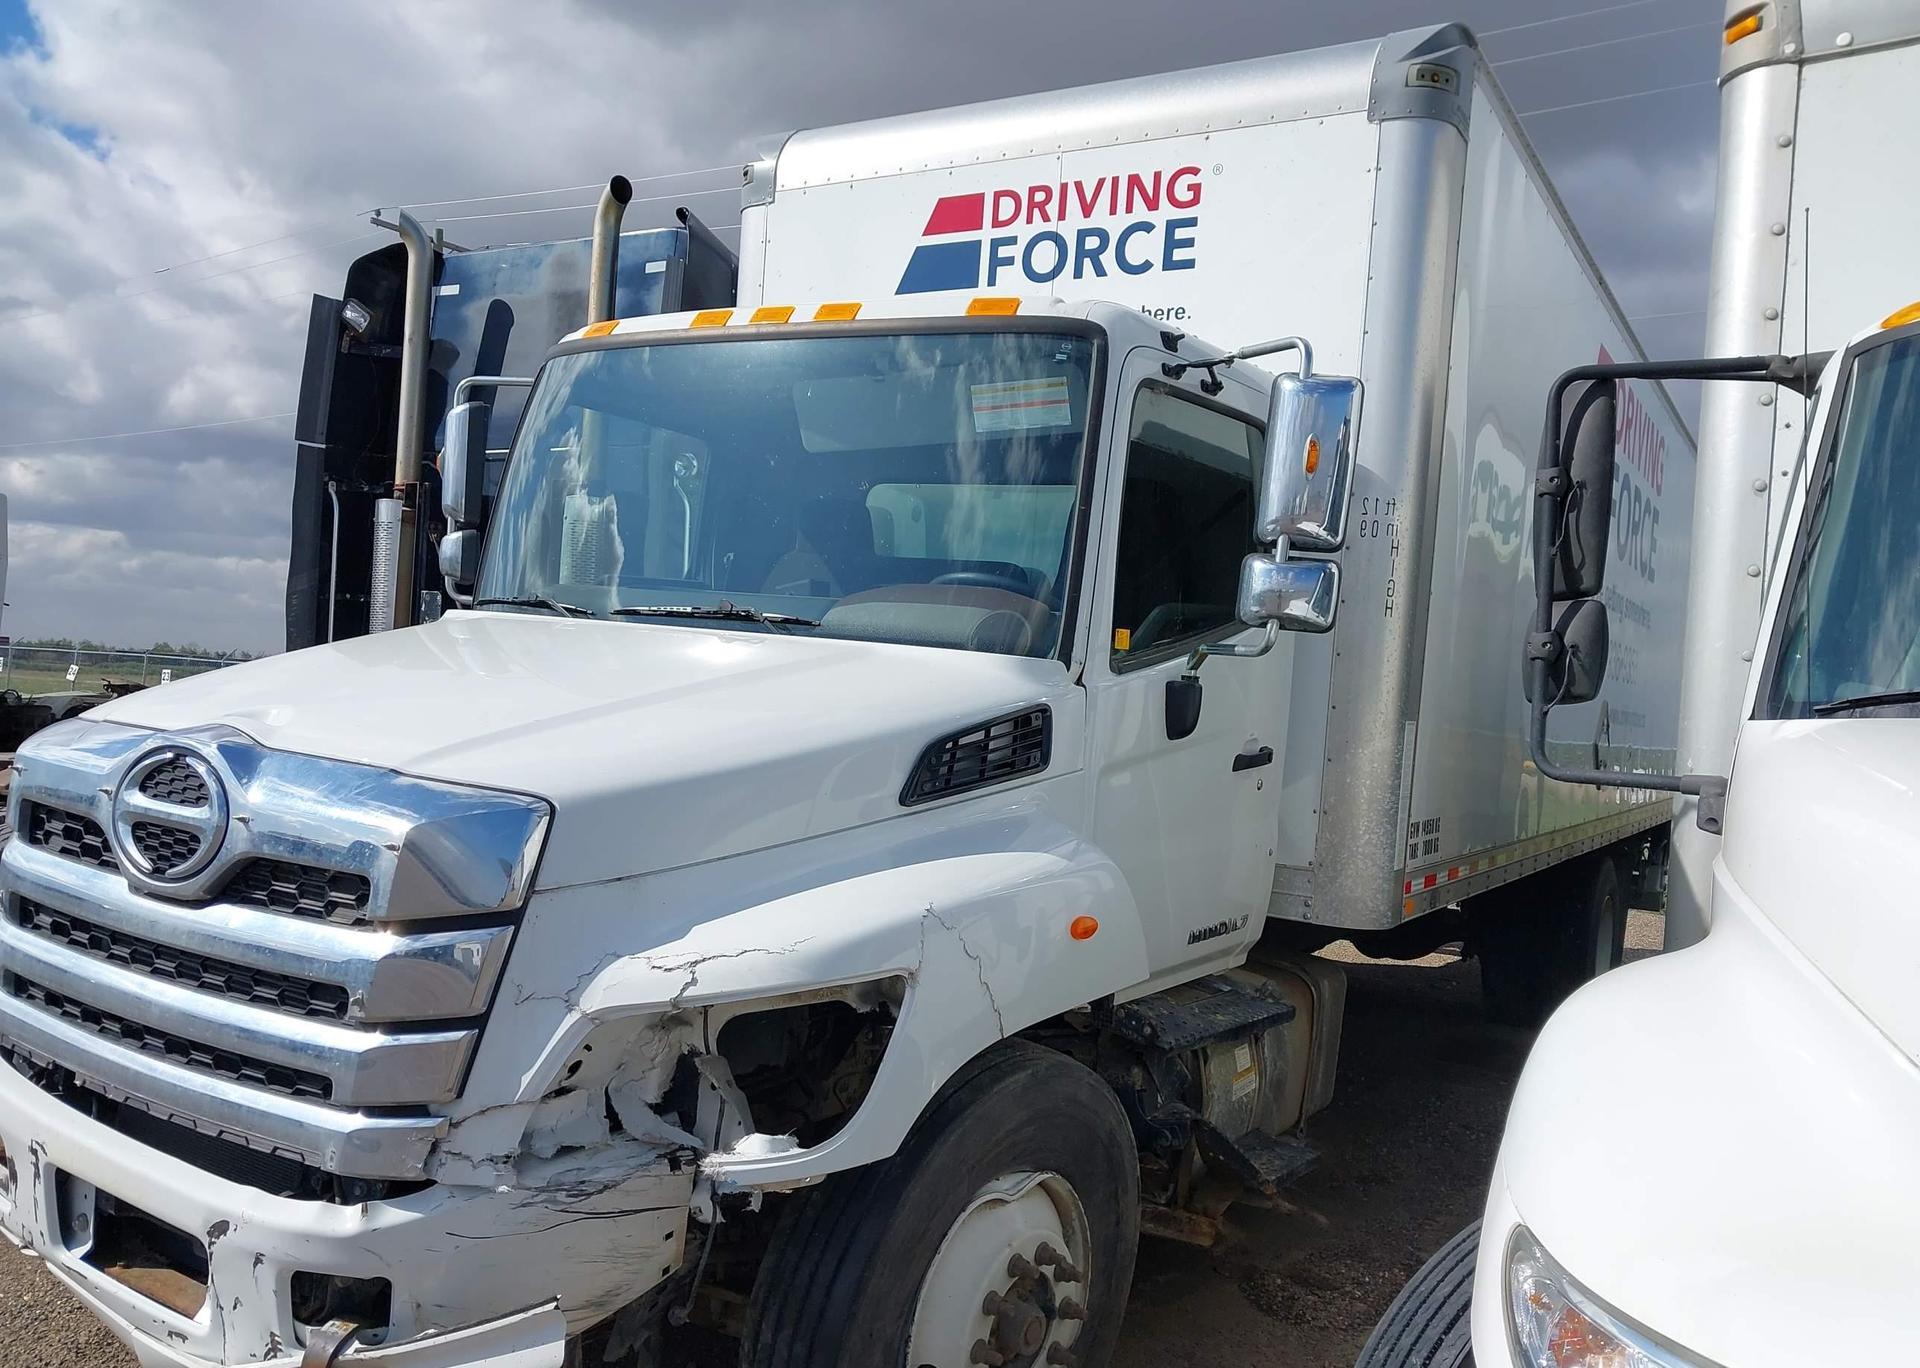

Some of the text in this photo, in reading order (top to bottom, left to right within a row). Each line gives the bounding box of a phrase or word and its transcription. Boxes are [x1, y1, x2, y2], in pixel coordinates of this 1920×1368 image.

[991, 166, 1202, 229] DRIVING
[987, 216, 1199, 287] FORCE
[1615, 378, 1665, 497] DRIVING
